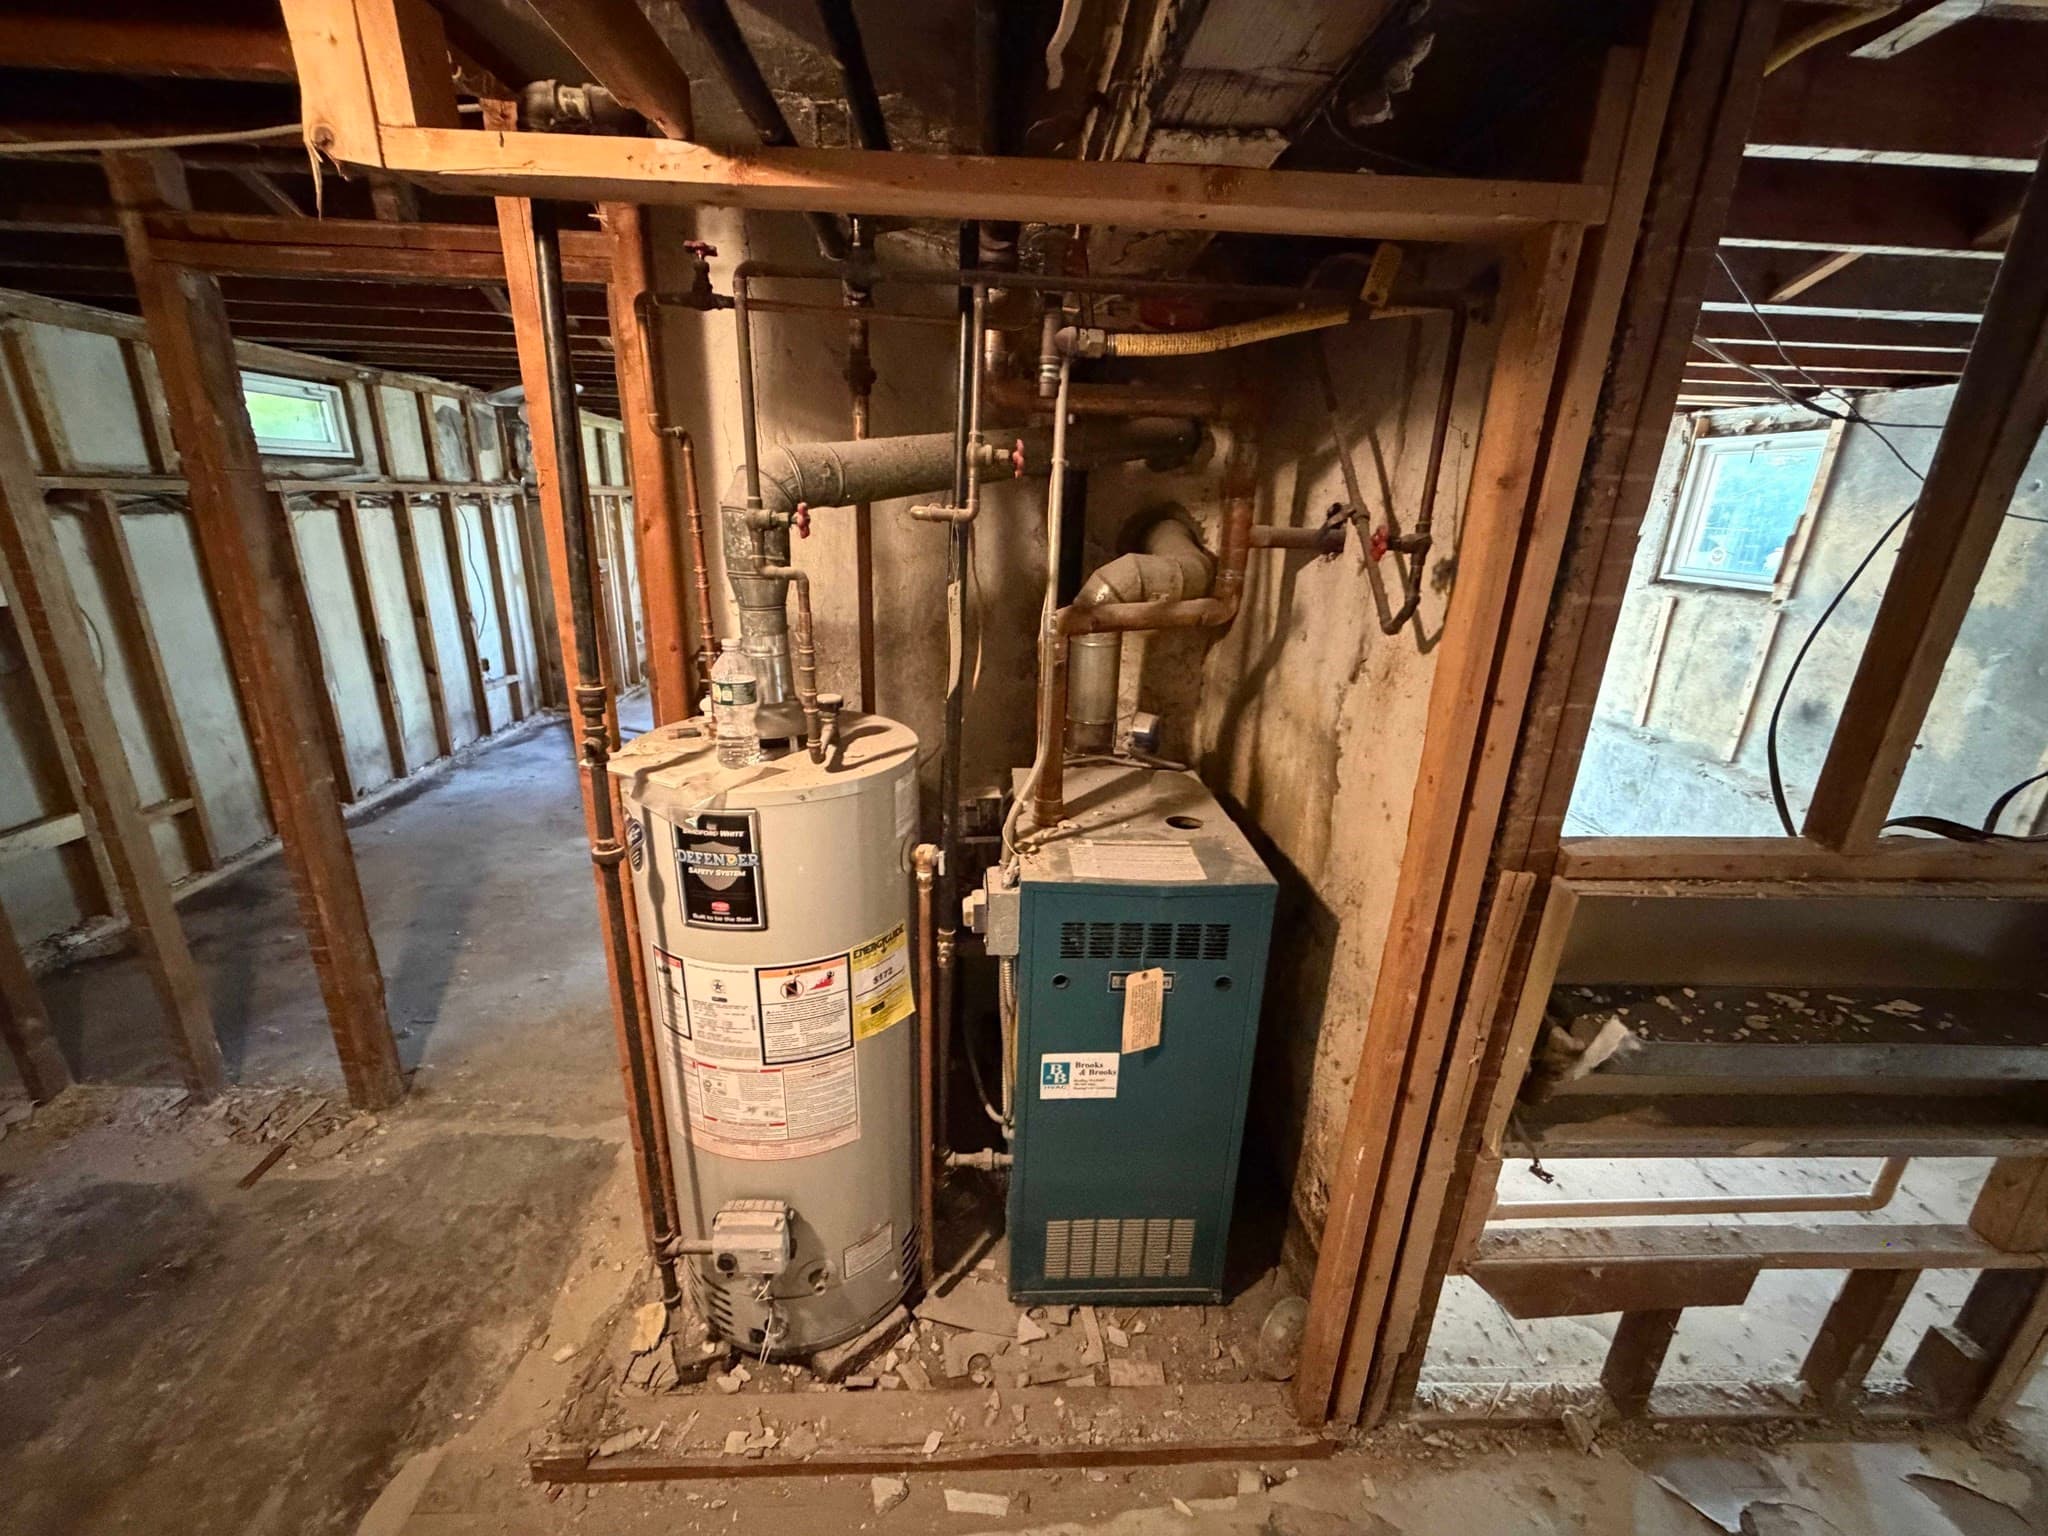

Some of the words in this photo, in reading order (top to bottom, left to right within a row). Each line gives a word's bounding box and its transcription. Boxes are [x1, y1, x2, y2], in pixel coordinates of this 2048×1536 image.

[676, 849, 759, 866] DEFENDER
[688, 866, 714, 875] SAFETY
[715, 869, 746, 877] SYSTEM
[1075, 1061, 1104, 1069] Brooks
